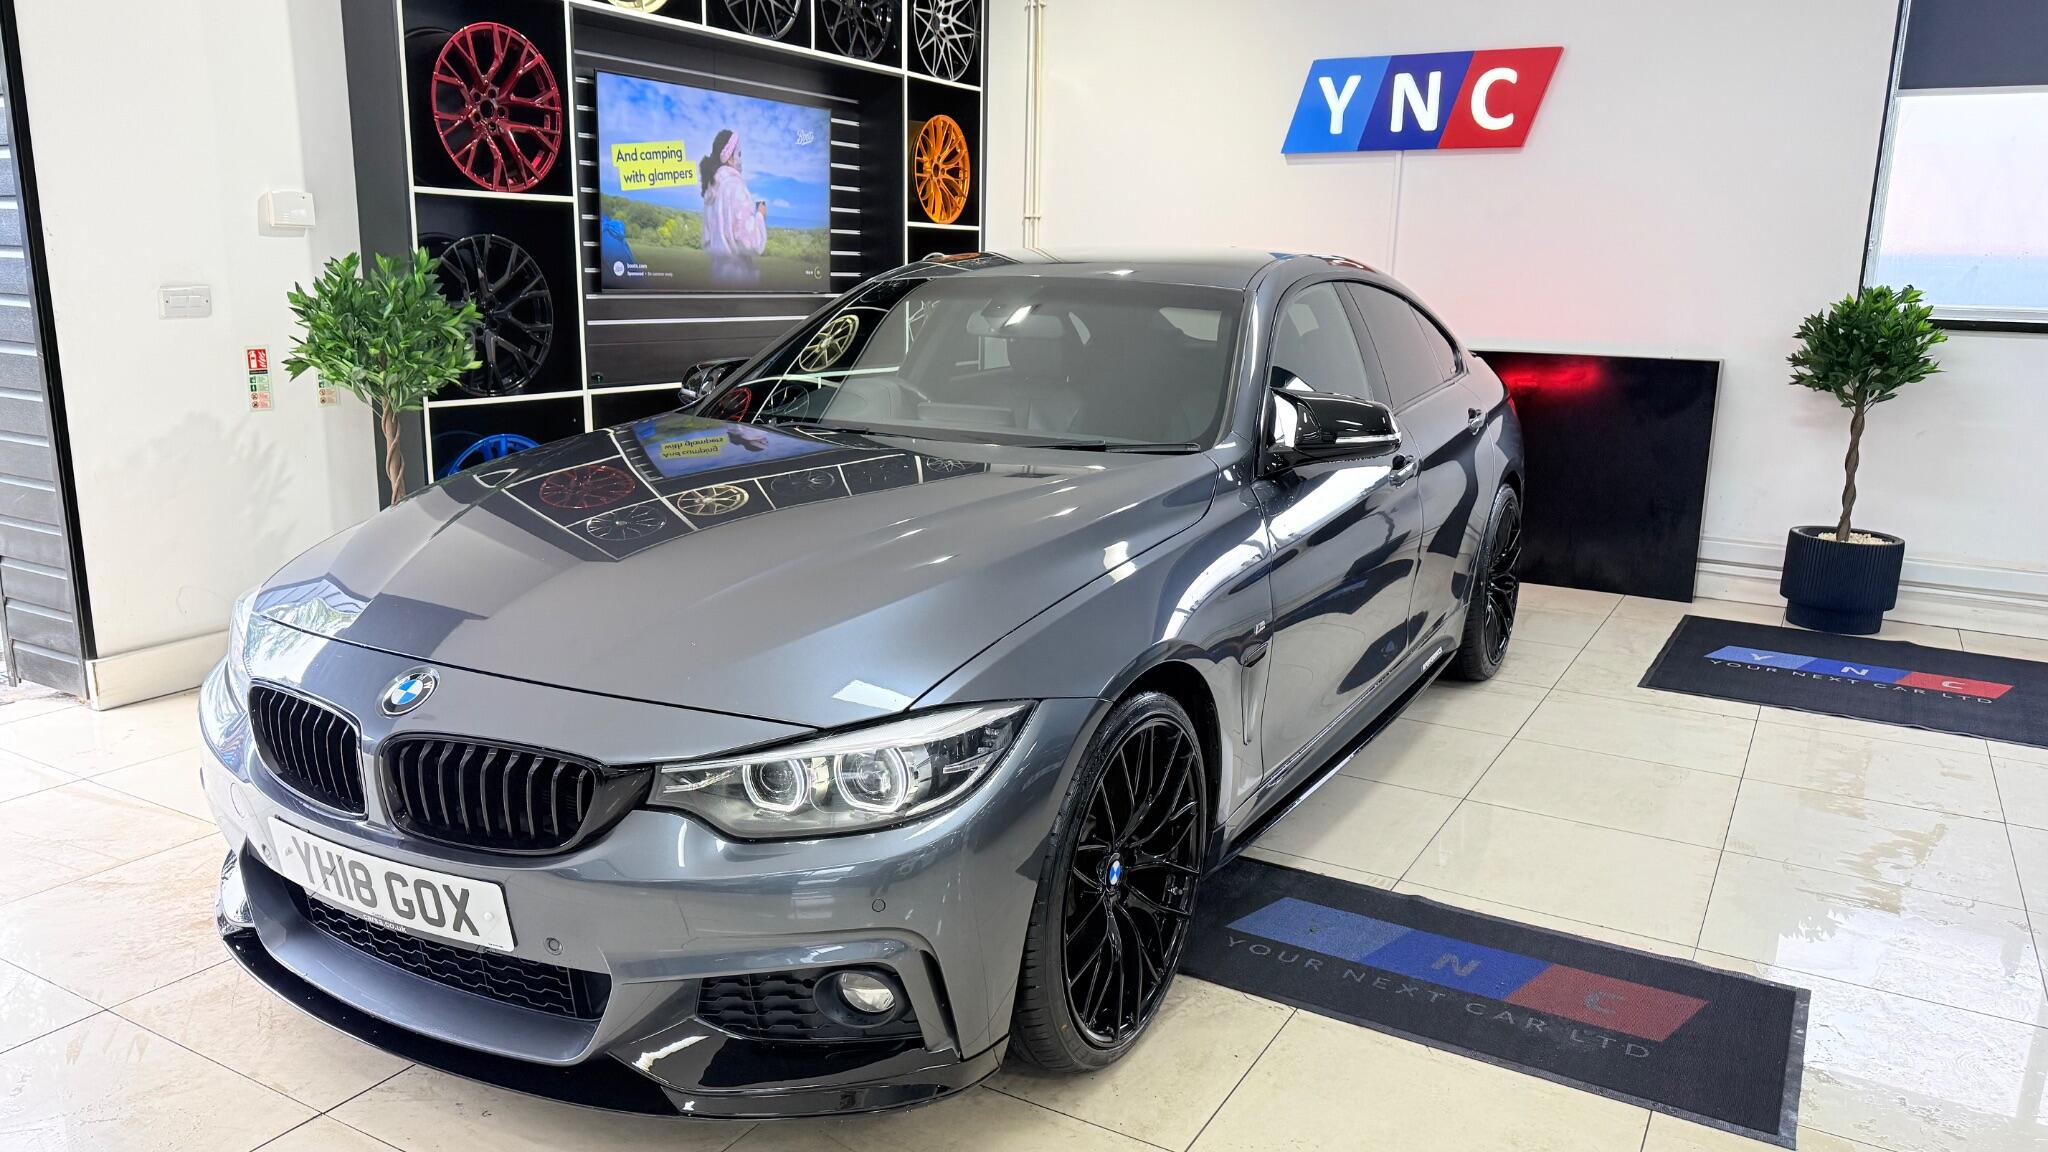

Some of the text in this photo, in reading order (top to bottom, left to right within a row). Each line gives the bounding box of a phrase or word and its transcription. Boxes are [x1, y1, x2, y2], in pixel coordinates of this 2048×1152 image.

[1318, 67, 1518, 135] YNC
[616, 146, 683, 164] And camping
[623, 168, 693, 186] with glampers
[1709, 659, 1993, 704] YOUR NEXT CAR LTD
[291, 835, 480, 937] YH18 GOX
[1226, 935, 1651, 1059] YOUR NEXT CAR LTD
